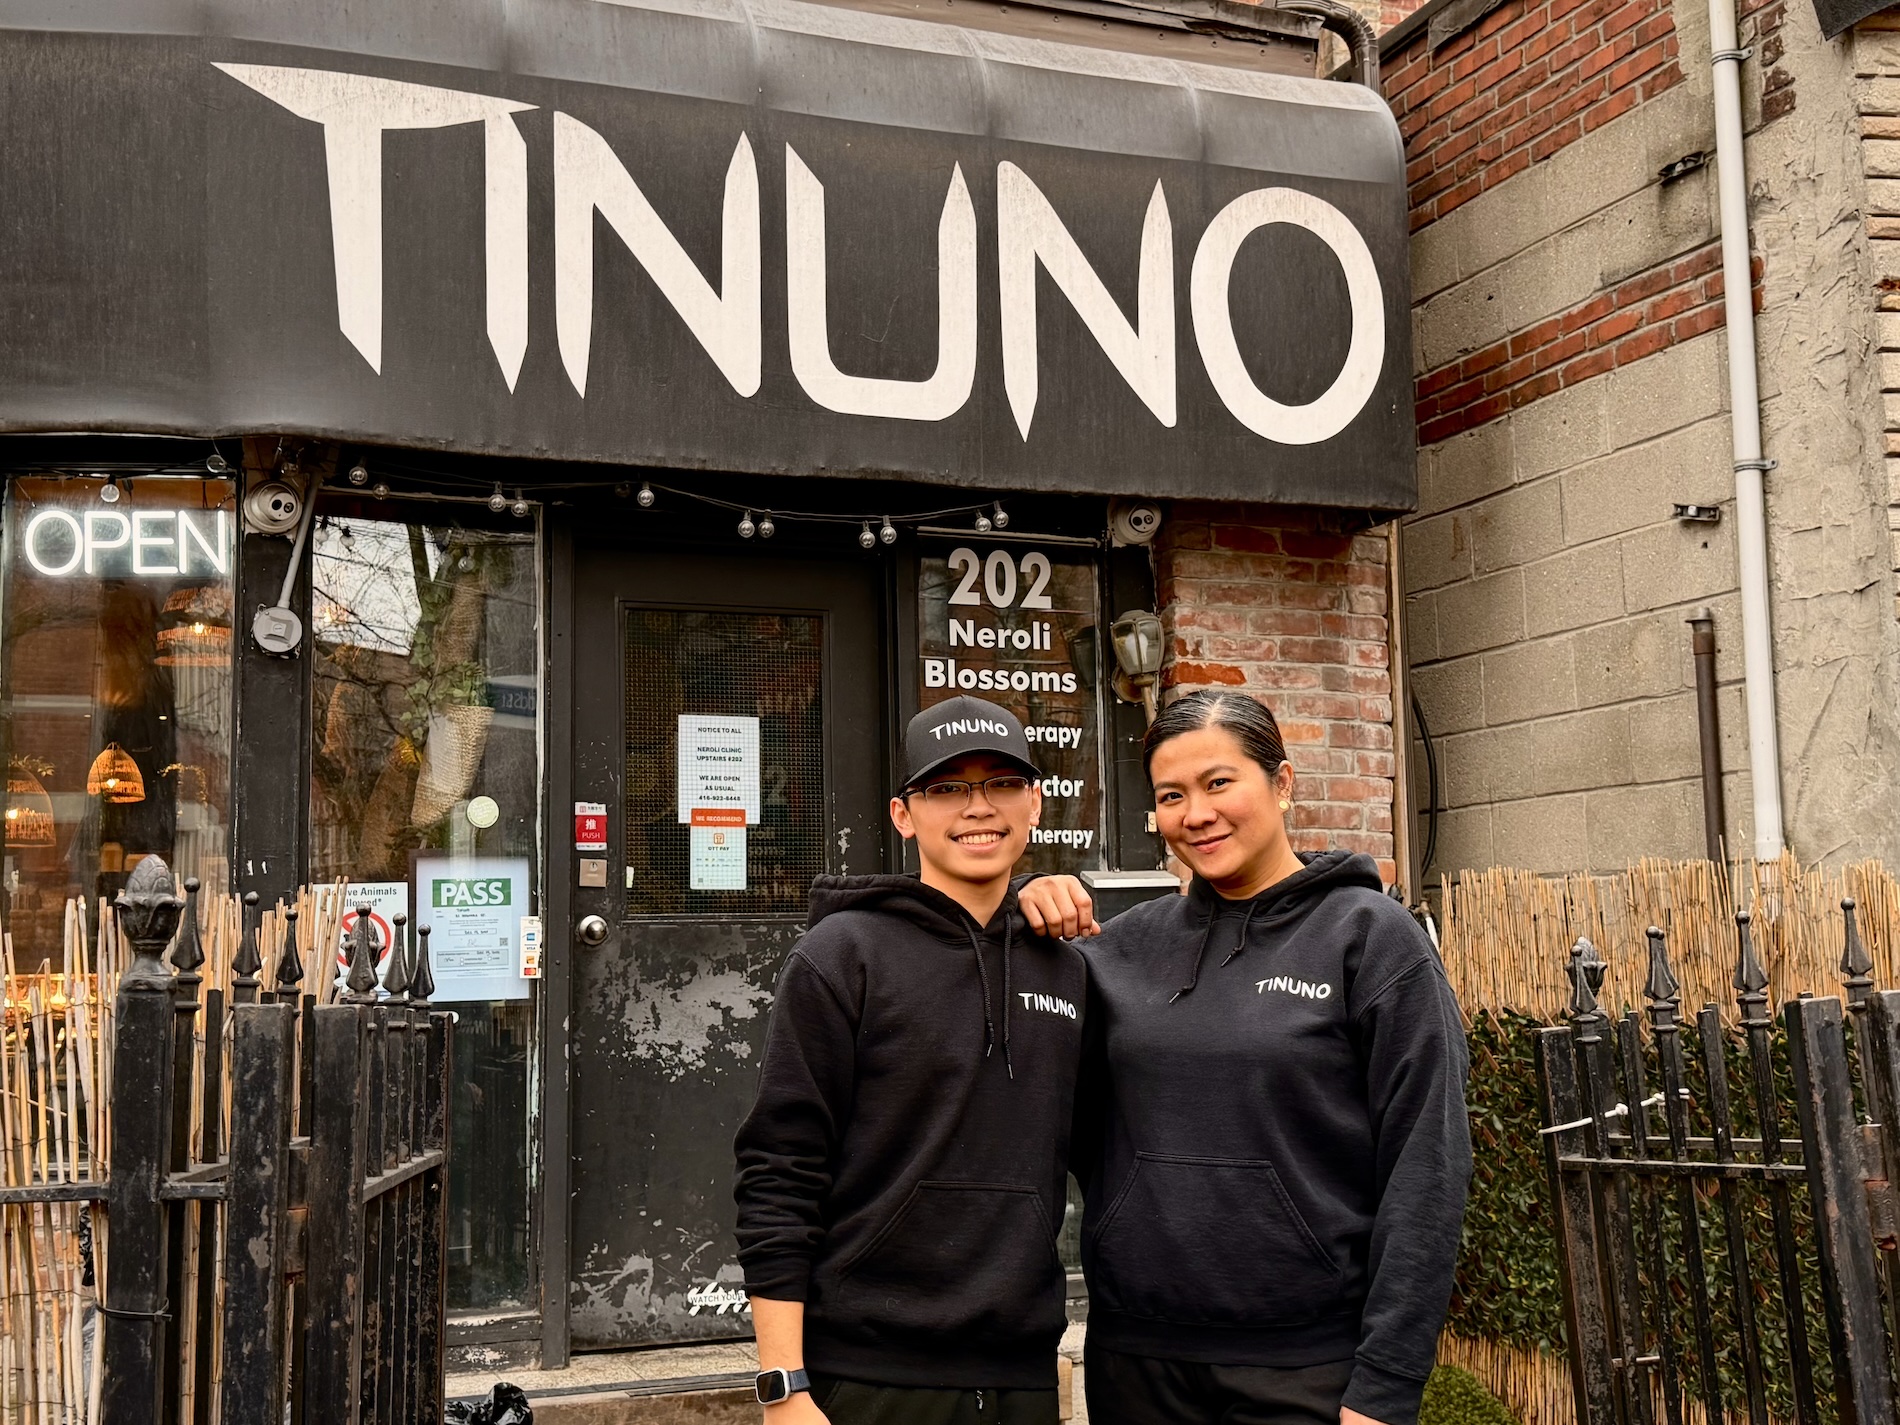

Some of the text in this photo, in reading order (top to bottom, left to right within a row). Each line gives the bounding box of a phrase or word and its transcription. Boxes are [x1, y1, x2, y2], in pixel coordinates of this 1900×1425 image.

[211, 62, 1385, 445] TINUNO
[24, 509, 228, 577] OPEN
[947, 547, 1053, 610] 202
[949, 618, 1052, 651] Neroli
[924, 659, 1078, 693] Blossoms
[929, 718, 1009, 741] TINUNO
[1024, 725, 1083, 749] erapy
[581, 831, 601, 839] PUSH
[585, 818, 597, 830] 推
[360, 886, 397, 896] Animals
[440, 881, 505, 906] PASS
[1254, 975, 1332, 999] TINUNO
[1017, 992, 1077, 1021] TINUNO
[690, 1292, 744, 1303] WATCH YOUR
